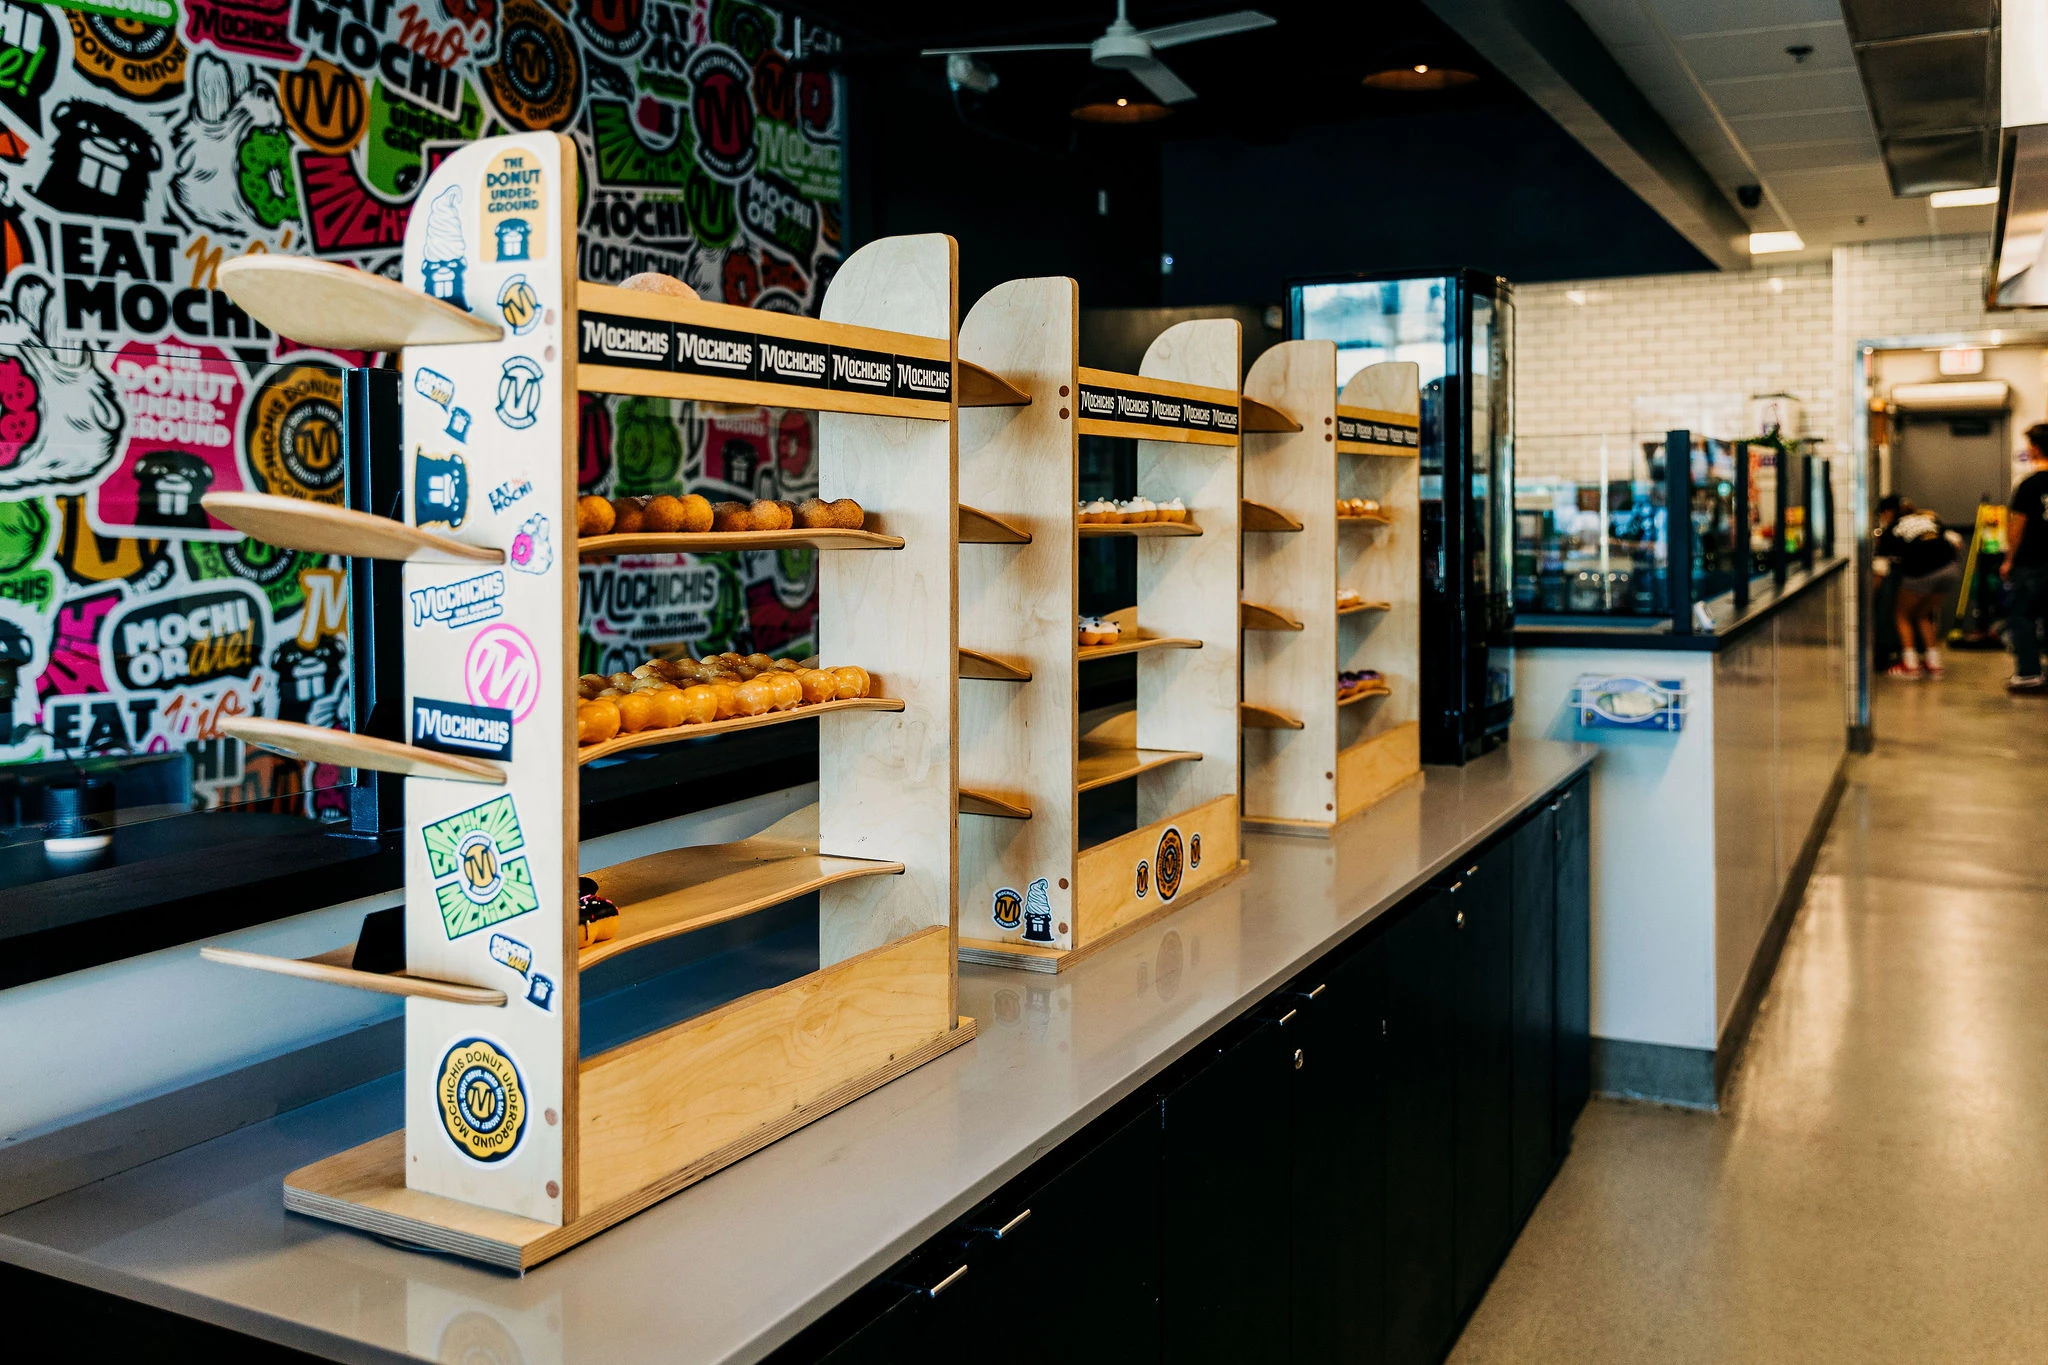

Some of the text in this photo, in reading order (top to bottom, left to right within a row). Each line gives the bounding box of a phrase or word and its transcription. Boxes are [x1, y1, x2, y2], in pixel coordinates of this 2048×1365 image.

[486, 169, 541, 188] DONUT
[503, 157, 524, 169] THE
[487, 200, 540, 213] GROUND
[490, 187, 537, 200] UNDER-
[60, 222, 180, 282] EAT
[156, 343, 202, 371] THE
[582, 320, 950, 394] MOCHICHIS MOCHICHIS MOCHICHIS MOCHICHIS MOCHICHIS
[115, 359, 238, 404] DONUT
[1081, 391, 1238, 429] MOCHICHIS MOCHICHIS MOCHICHIS MOCHICHIS MOCHICHIS
[488, 481, 510, 504] EAT
[411, 572, 504, 627] MOCHICHIS
[123, 598, 251, 657] MOCHI
[127, 646, 191, 687] OR
[53, 698, 158, 750] EAT
[416, 706, 510, 752] MOCHICHIS
[446, 1050, 519, 1149] MOCHICHIS DONUT UNDERGROUND
